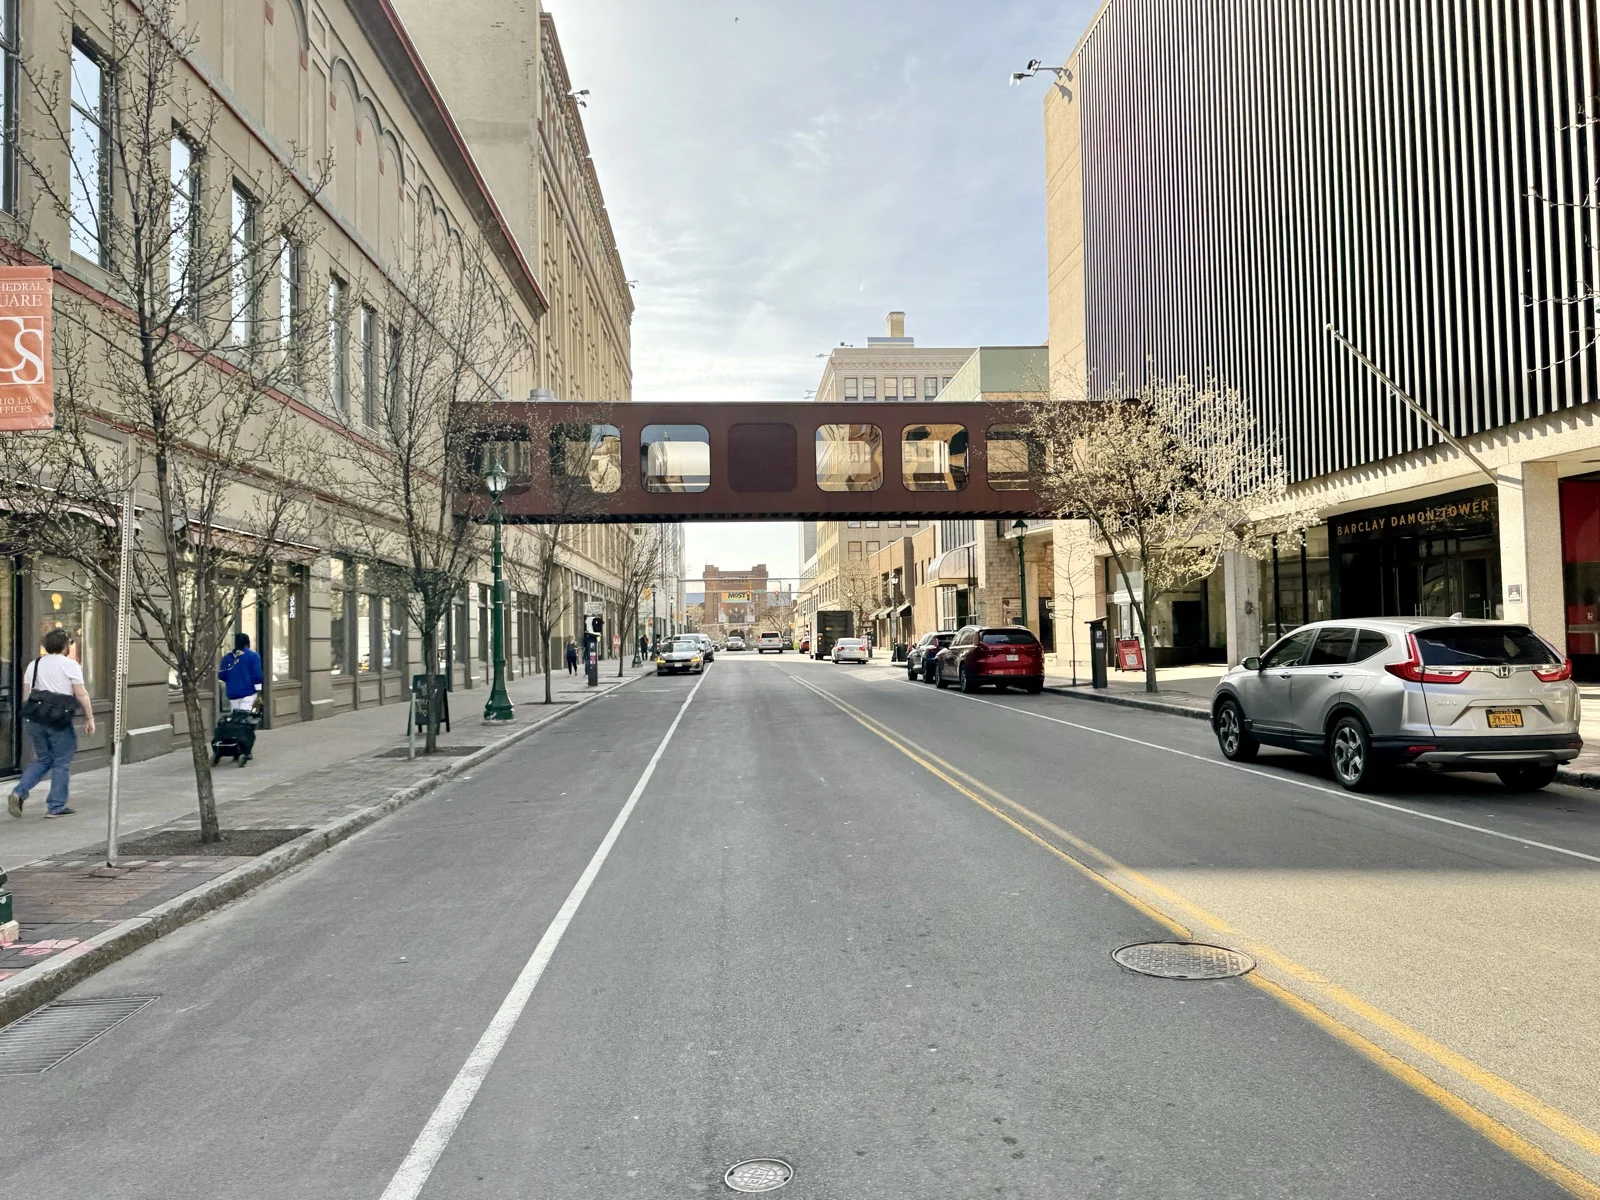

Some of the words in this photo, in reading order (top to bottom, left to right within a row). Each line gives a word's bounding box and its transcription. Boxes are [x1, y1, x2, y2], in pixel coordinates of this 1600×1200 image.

[18, 396, 39, 405] LAW
[1337, 518, 1385, 536] BARCLAY
[1391, 510, 1434, 527] DAMON
[1441, 500, 1489, 519] TOWER
